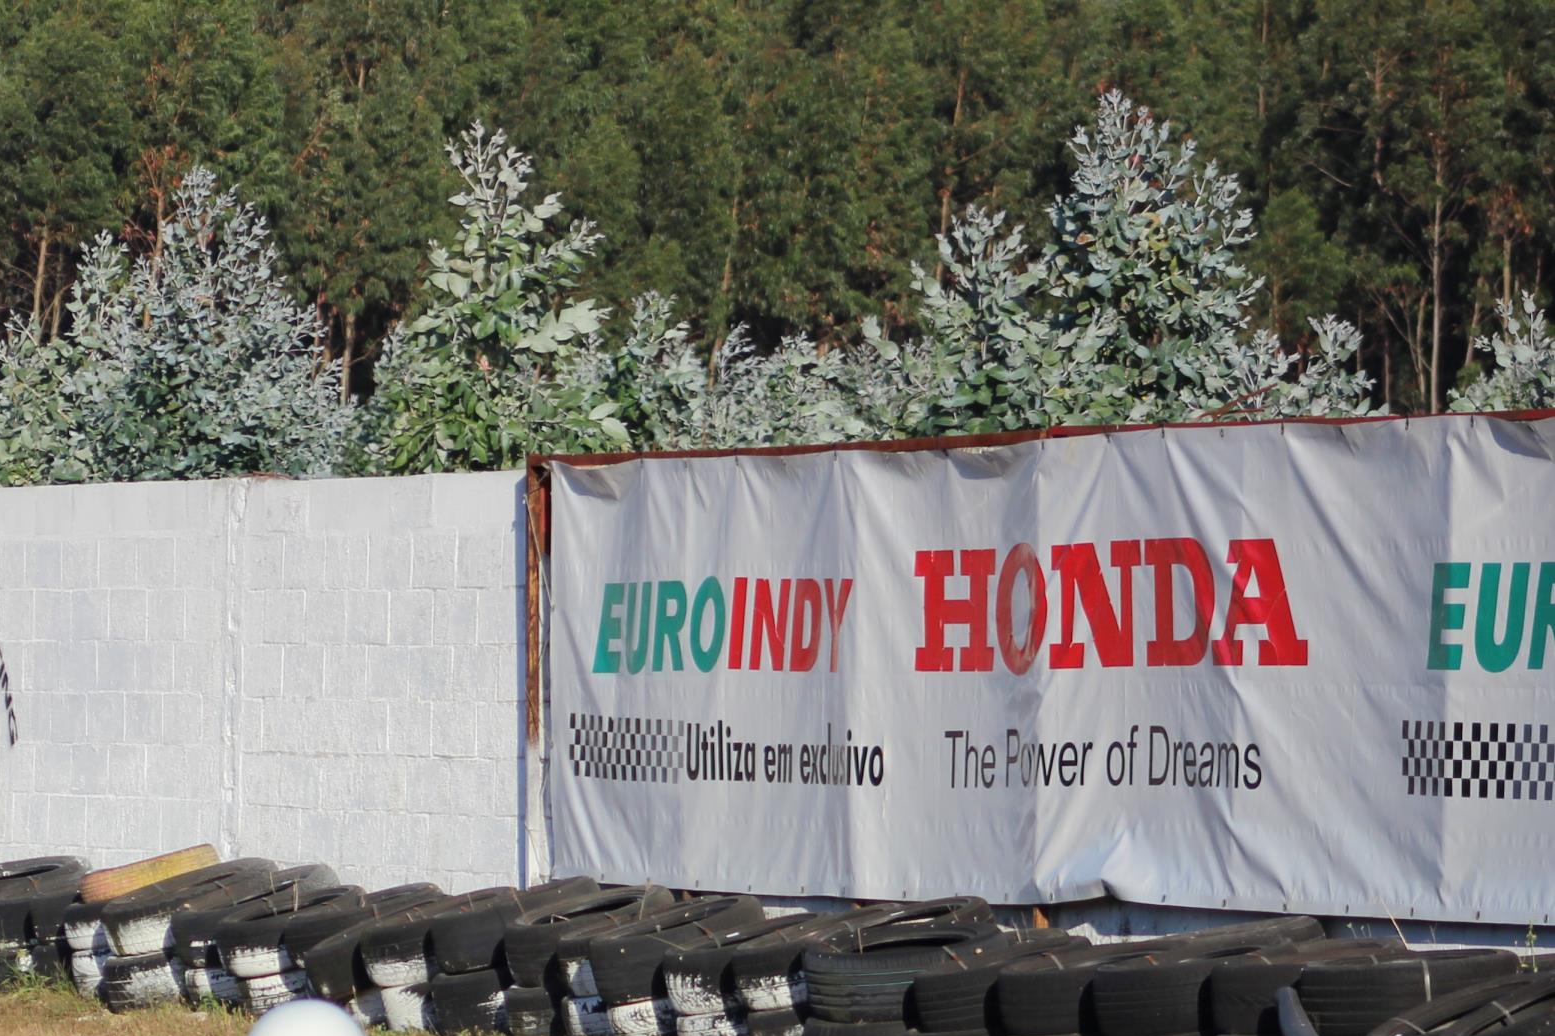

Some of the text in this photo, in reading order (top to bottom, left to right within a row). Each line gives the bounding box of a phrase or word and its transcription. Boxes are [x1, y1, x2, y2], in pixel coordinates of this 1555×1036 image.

[592, 575, 854, 675] EUROINDY
[914, 537, 1308, 676] HONDA
[686, 719, 884, 787] Utiliza em exclusivo
[944, 725, 1263, 790] The Power of Dreams
